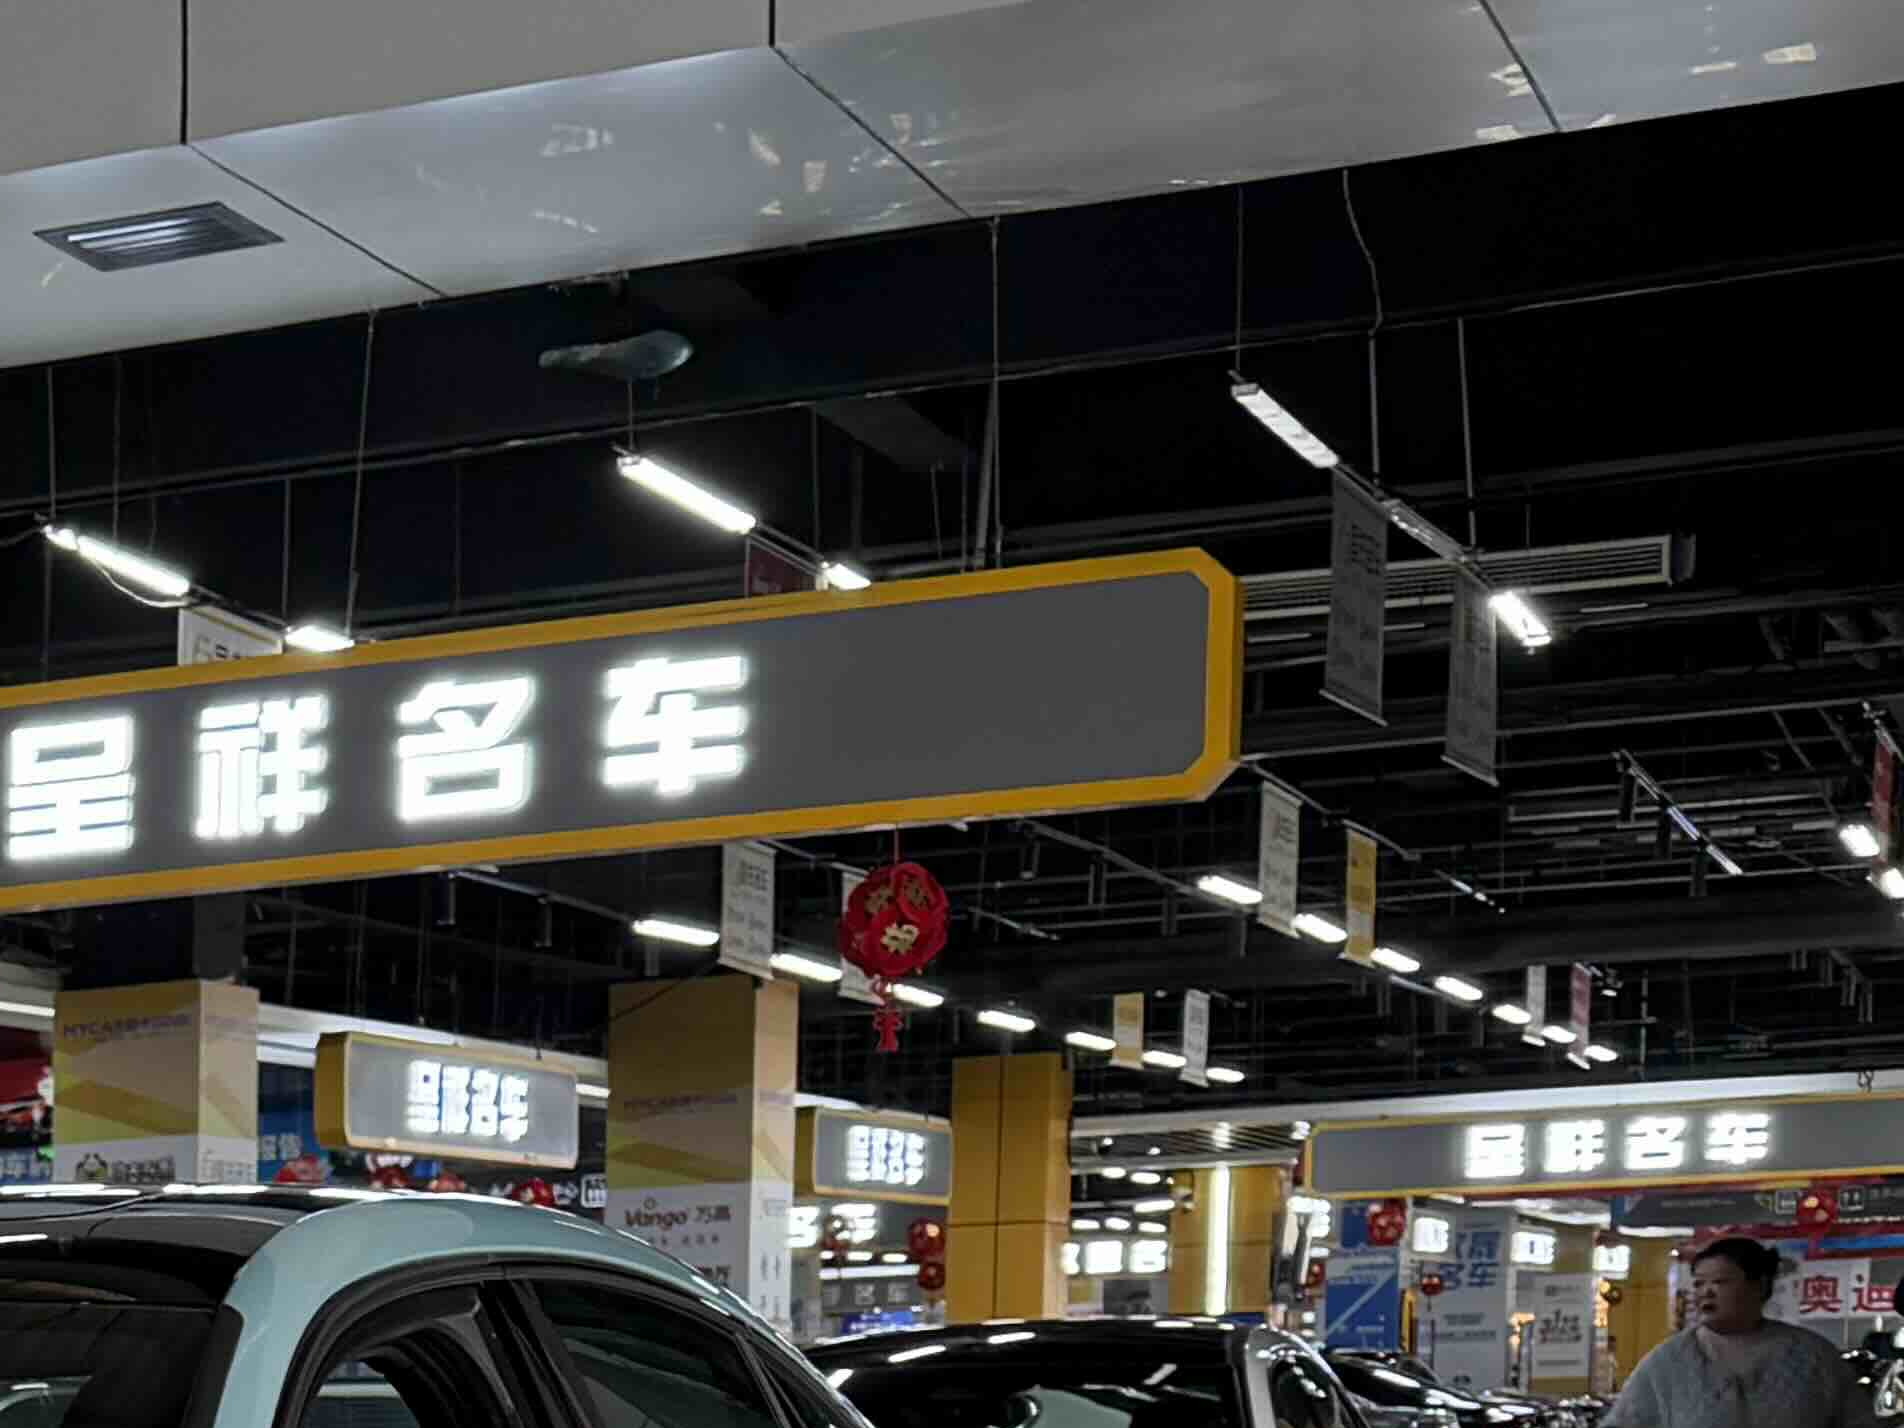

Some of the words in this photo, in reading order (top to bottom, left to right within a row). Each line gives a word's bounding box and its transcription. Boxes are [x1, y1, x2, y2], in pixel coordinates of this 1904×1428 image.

[5, 654, 748, 862] 呈祥名车
[1464, 1112, 1770, 1180] 呈祥名车
